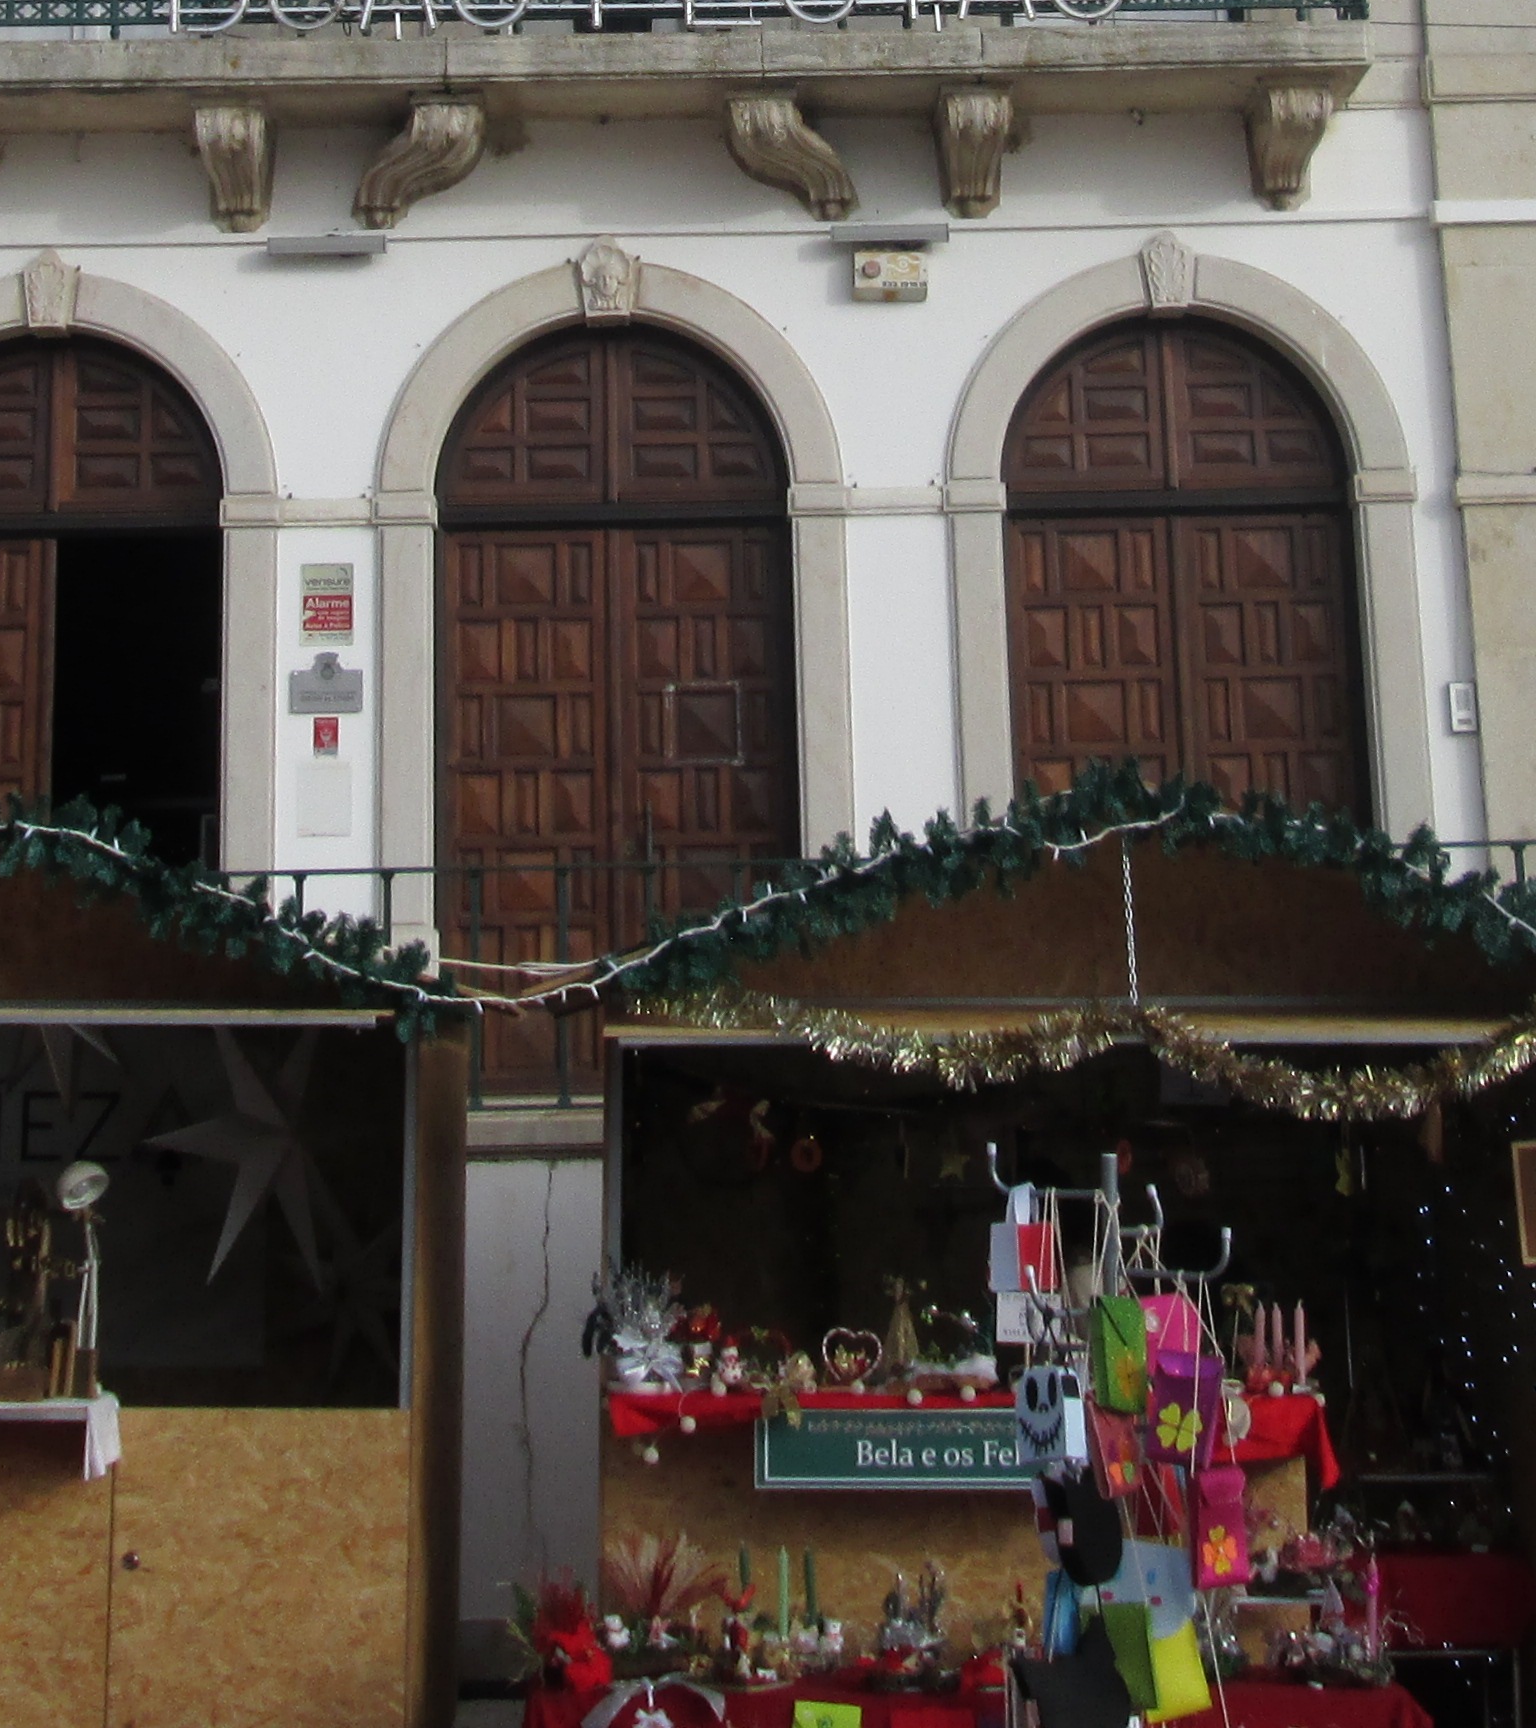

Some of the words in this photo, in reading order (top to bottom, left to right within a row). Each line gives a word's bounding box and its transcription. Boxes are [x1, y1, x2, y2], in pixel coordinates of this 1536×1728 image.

[305, 597, 350, 609] Alarme
[855, 1440, 914, 1467] Bela
[921, 1447, 936, 1467] e
[943, 1446, 975, 1467] os
[982, 1439, 1020, 1466] Fel
